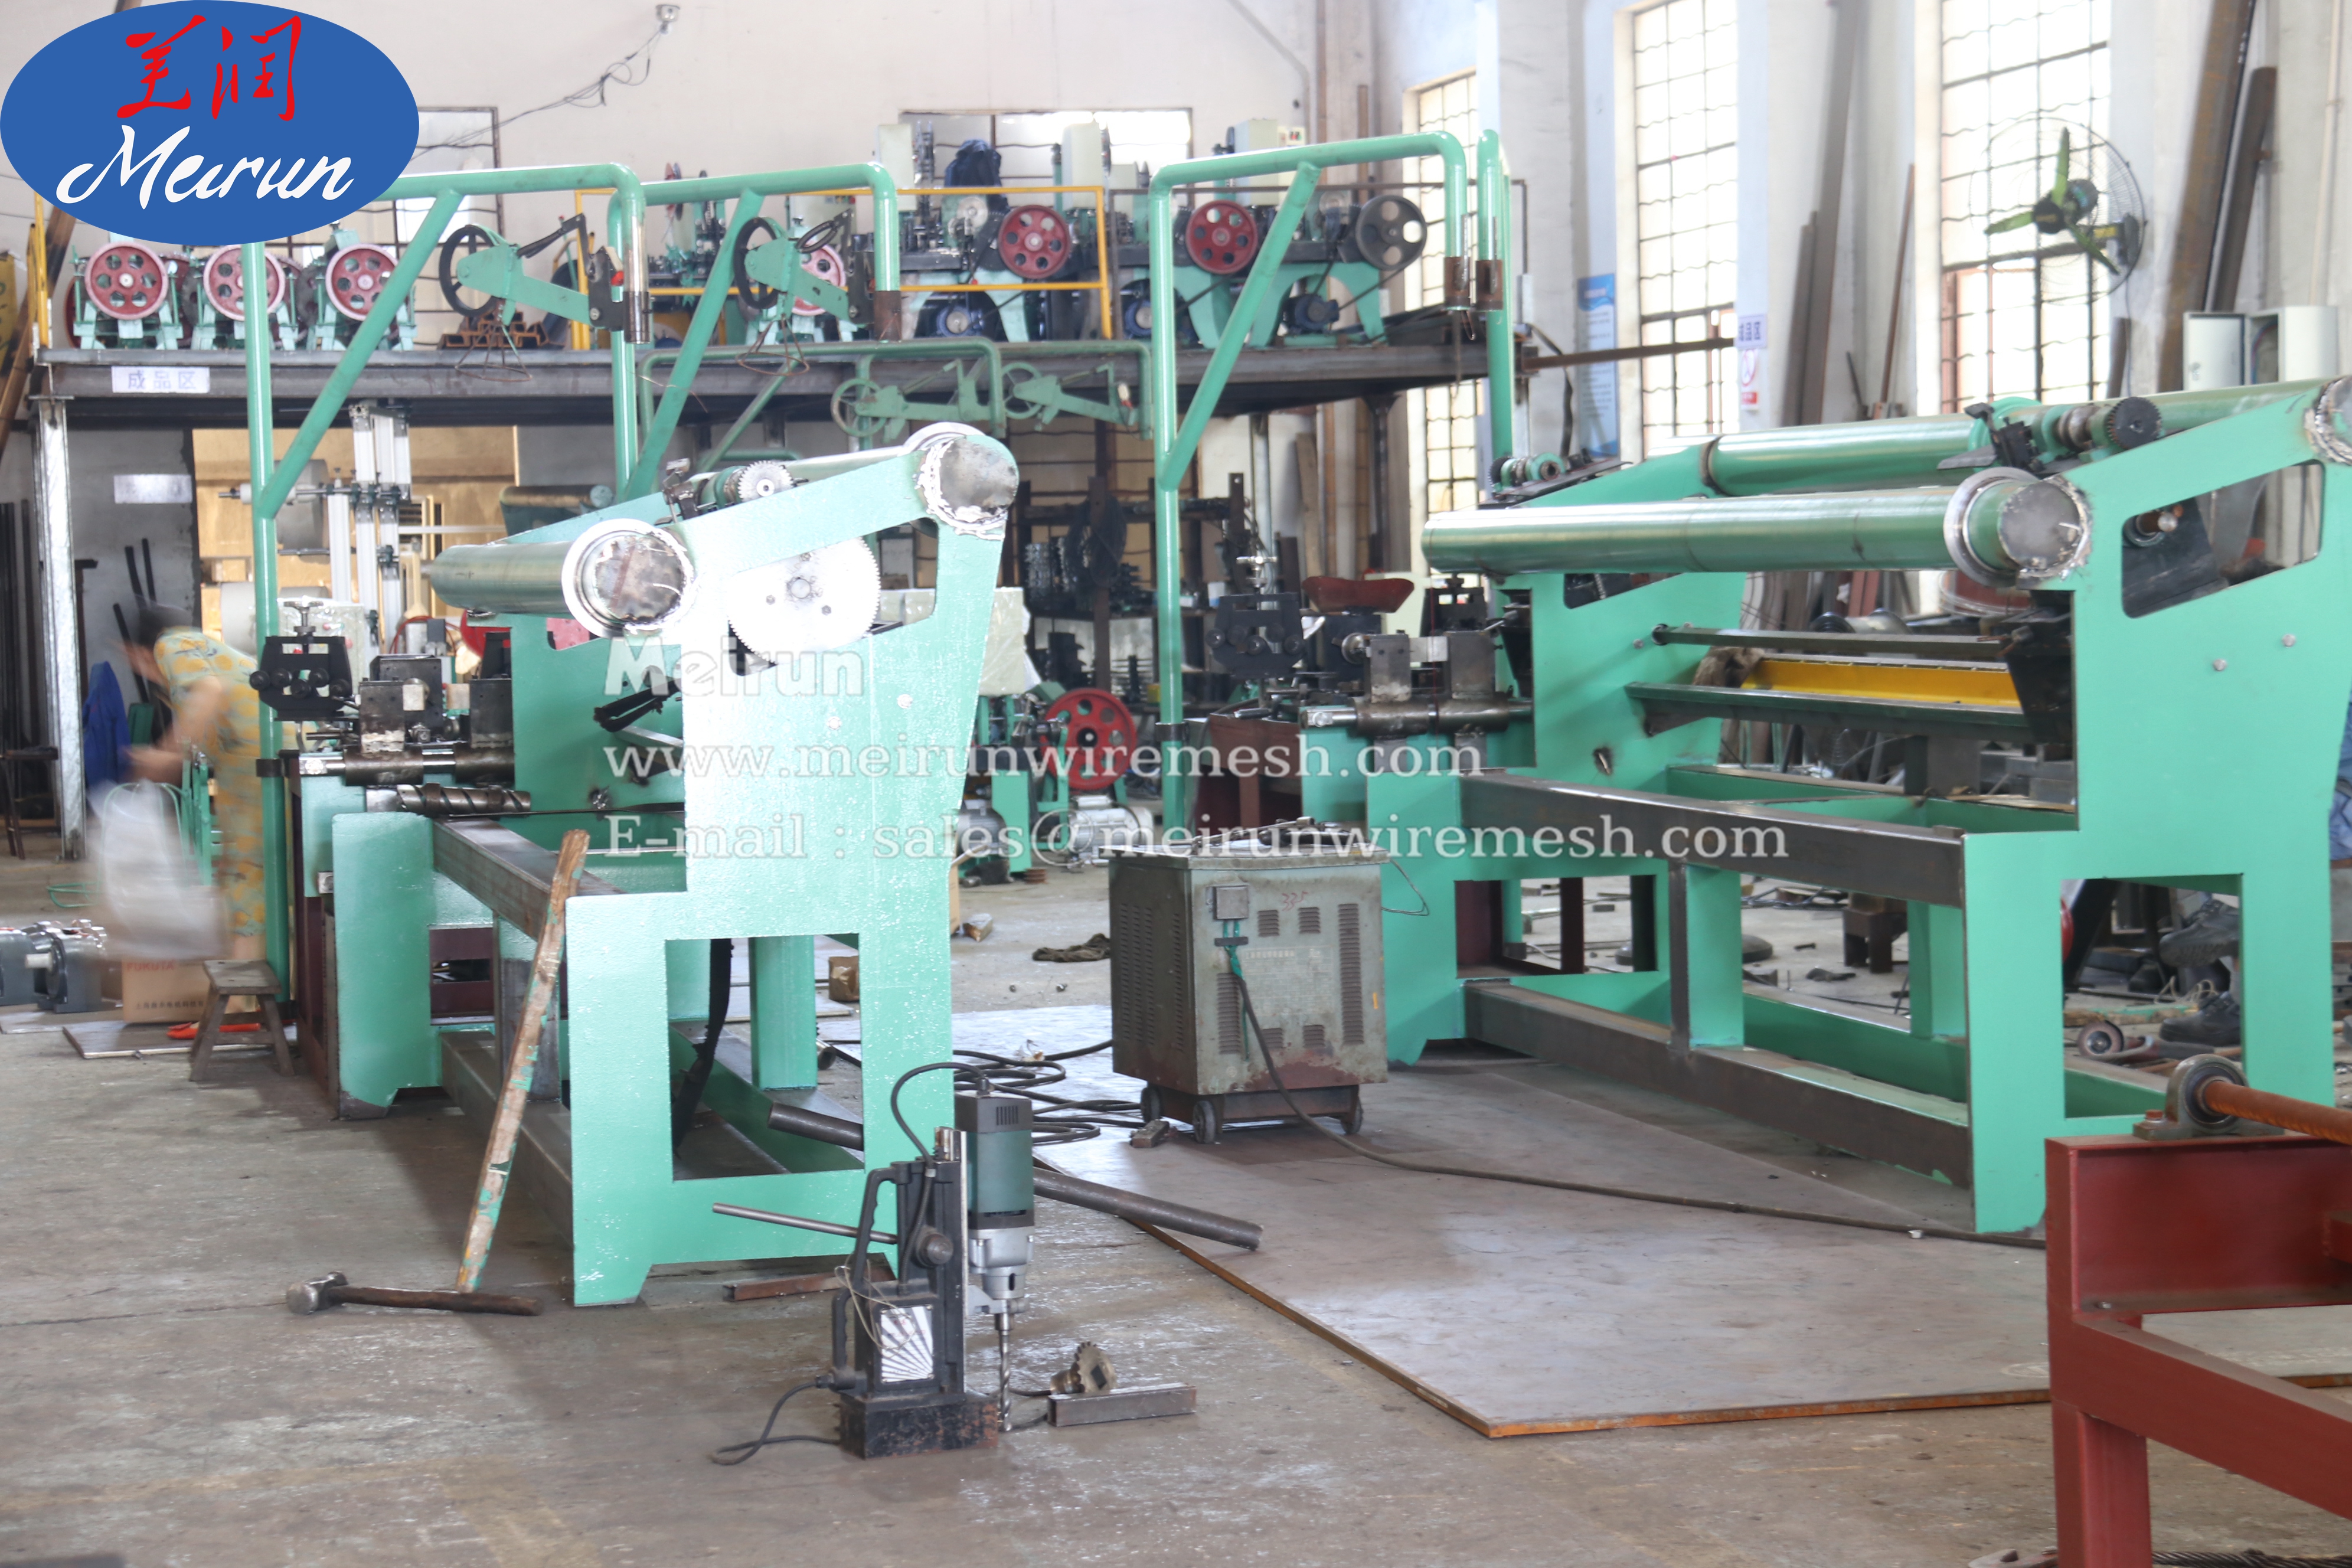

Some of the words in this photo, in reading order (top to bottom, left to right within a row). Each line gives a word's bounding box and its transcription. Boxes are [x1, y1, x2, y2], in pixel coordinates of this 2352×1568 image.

[128, 370, 196, 390] 成品区
[126, 960, 175, 971] FUKUTA
